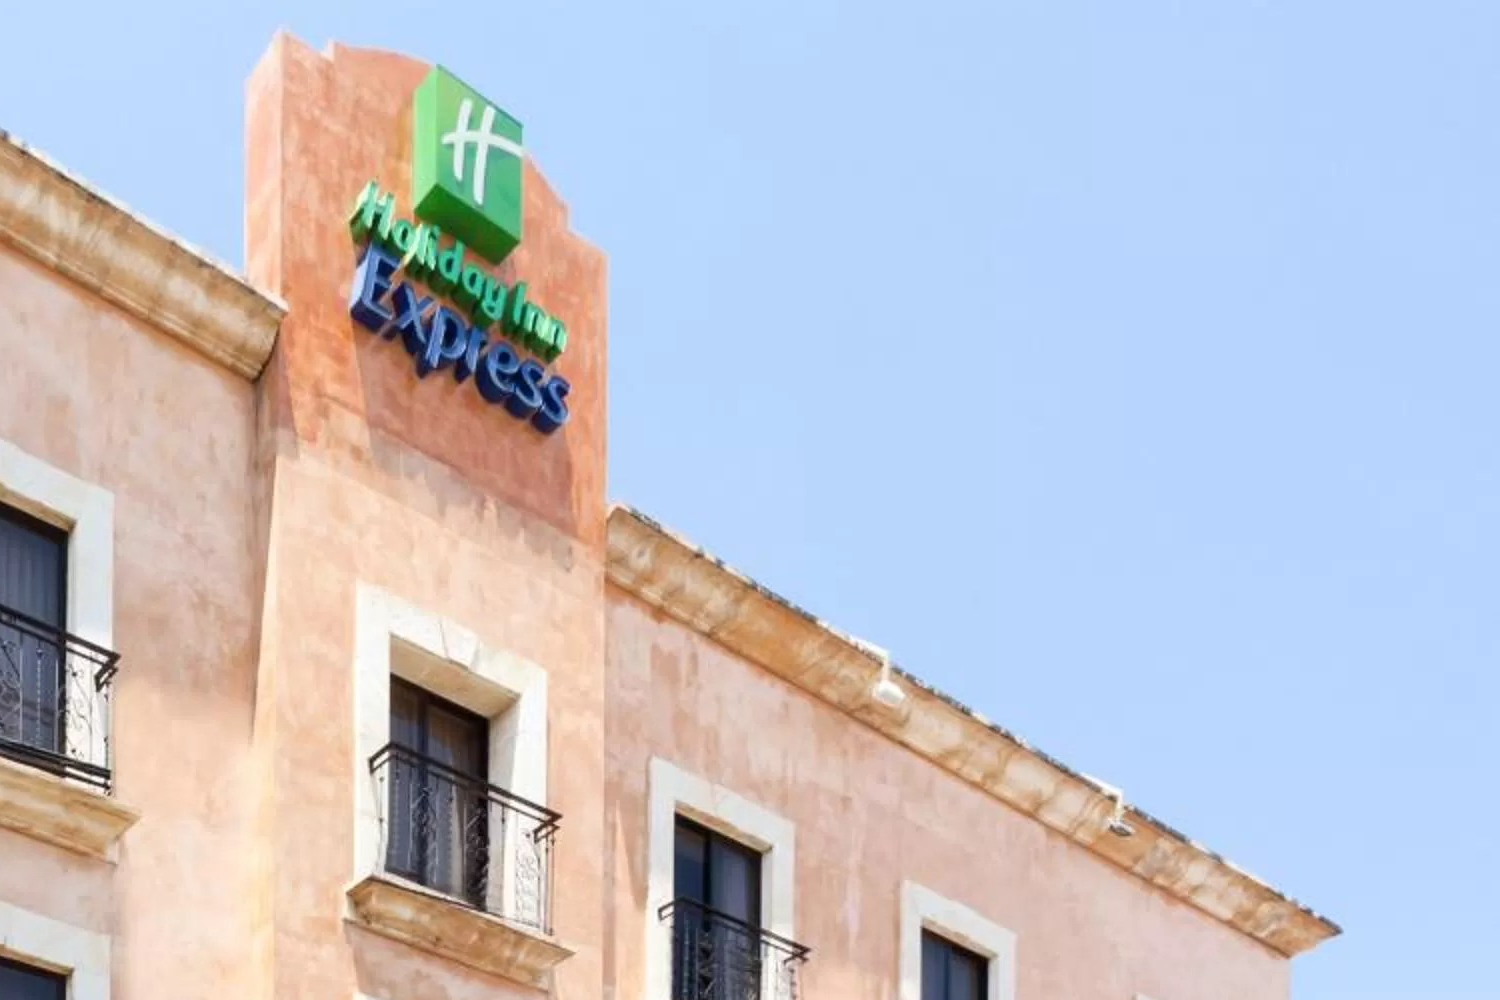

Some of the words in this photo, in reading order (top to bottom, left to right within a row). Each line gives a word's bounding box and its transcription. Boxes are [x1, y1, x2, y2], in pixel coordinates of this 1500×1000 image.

[349, 180, 508, 324] Holiday
[511, 281, 568, 357] Inn
[349, 242, 571, 430] Express
